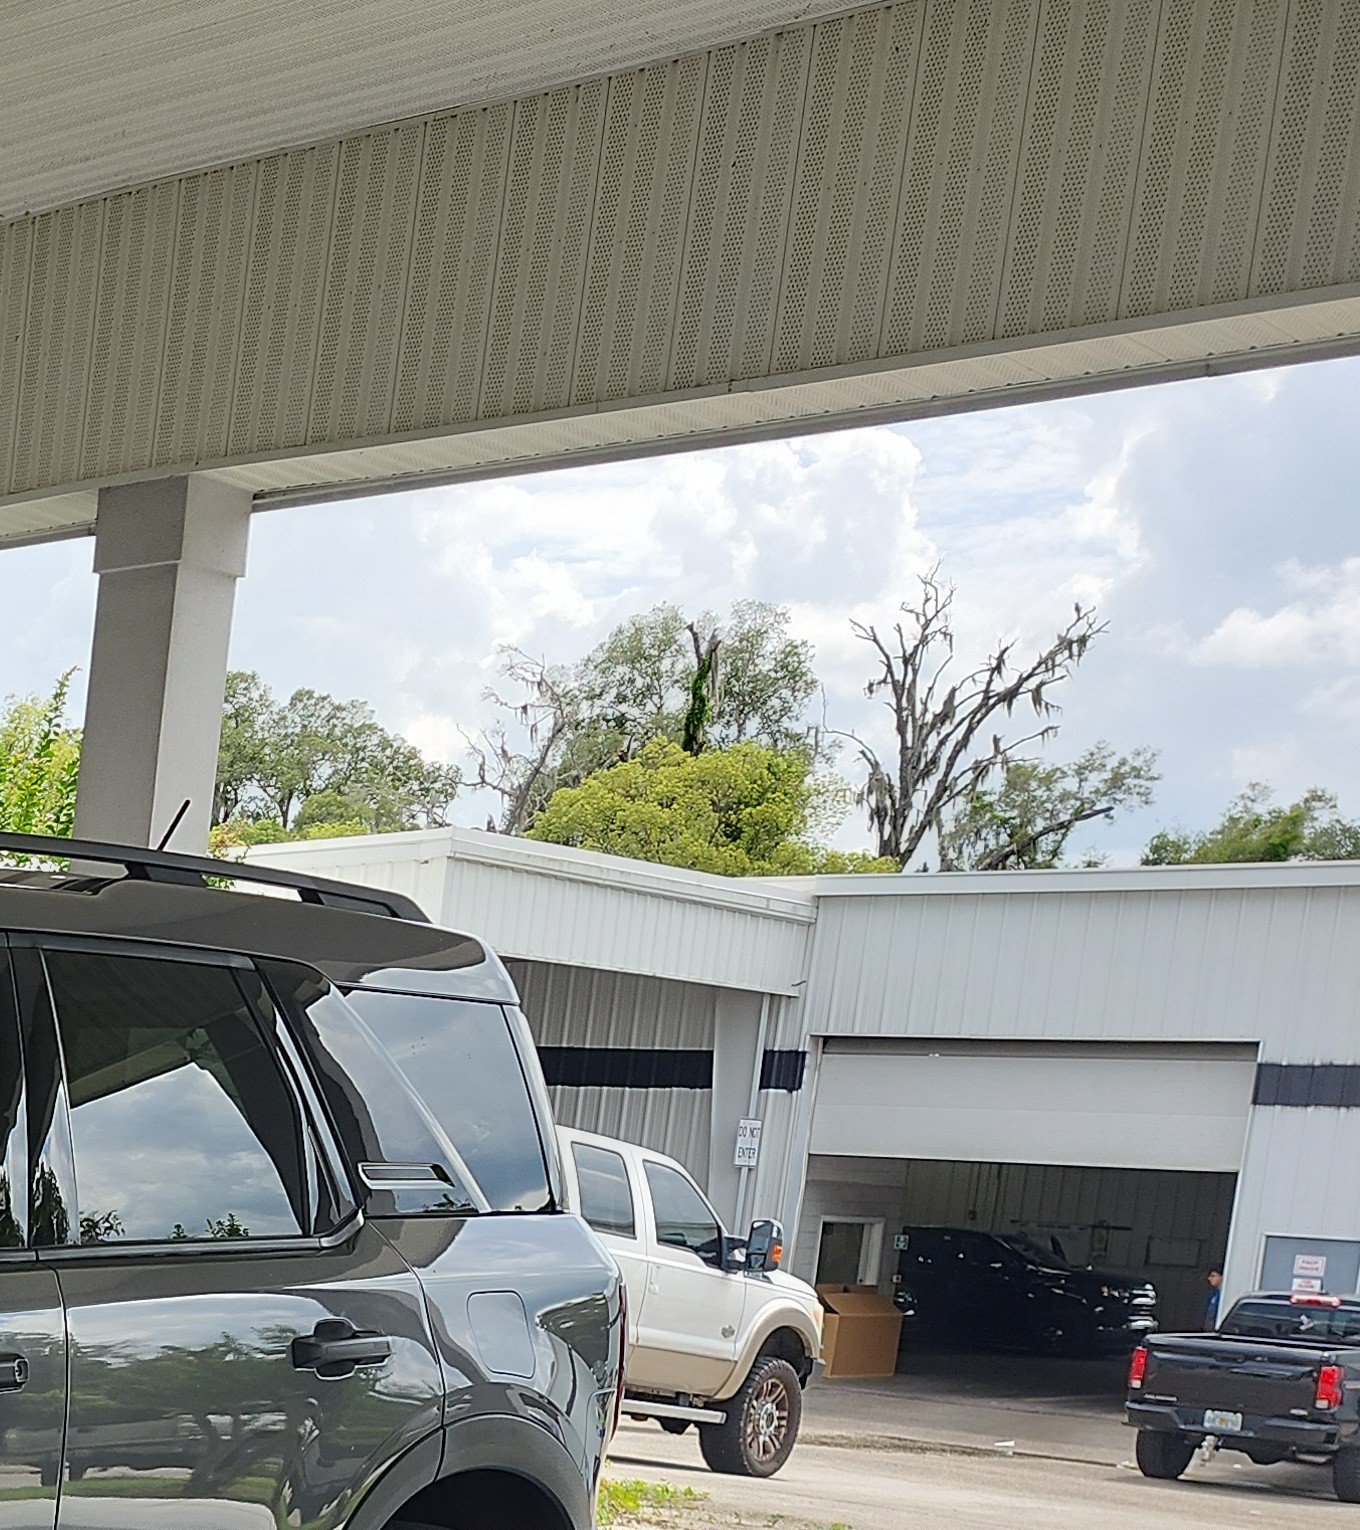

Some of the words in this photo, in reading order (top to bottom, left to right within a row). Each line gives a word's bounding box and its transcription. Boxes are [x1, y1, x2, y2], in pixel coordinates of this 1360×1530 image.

[738, 1125, 747, 1138] DO
[749, 1126, 761, 1139] NOT
[737, 1146, 757, 1159] ENTER
